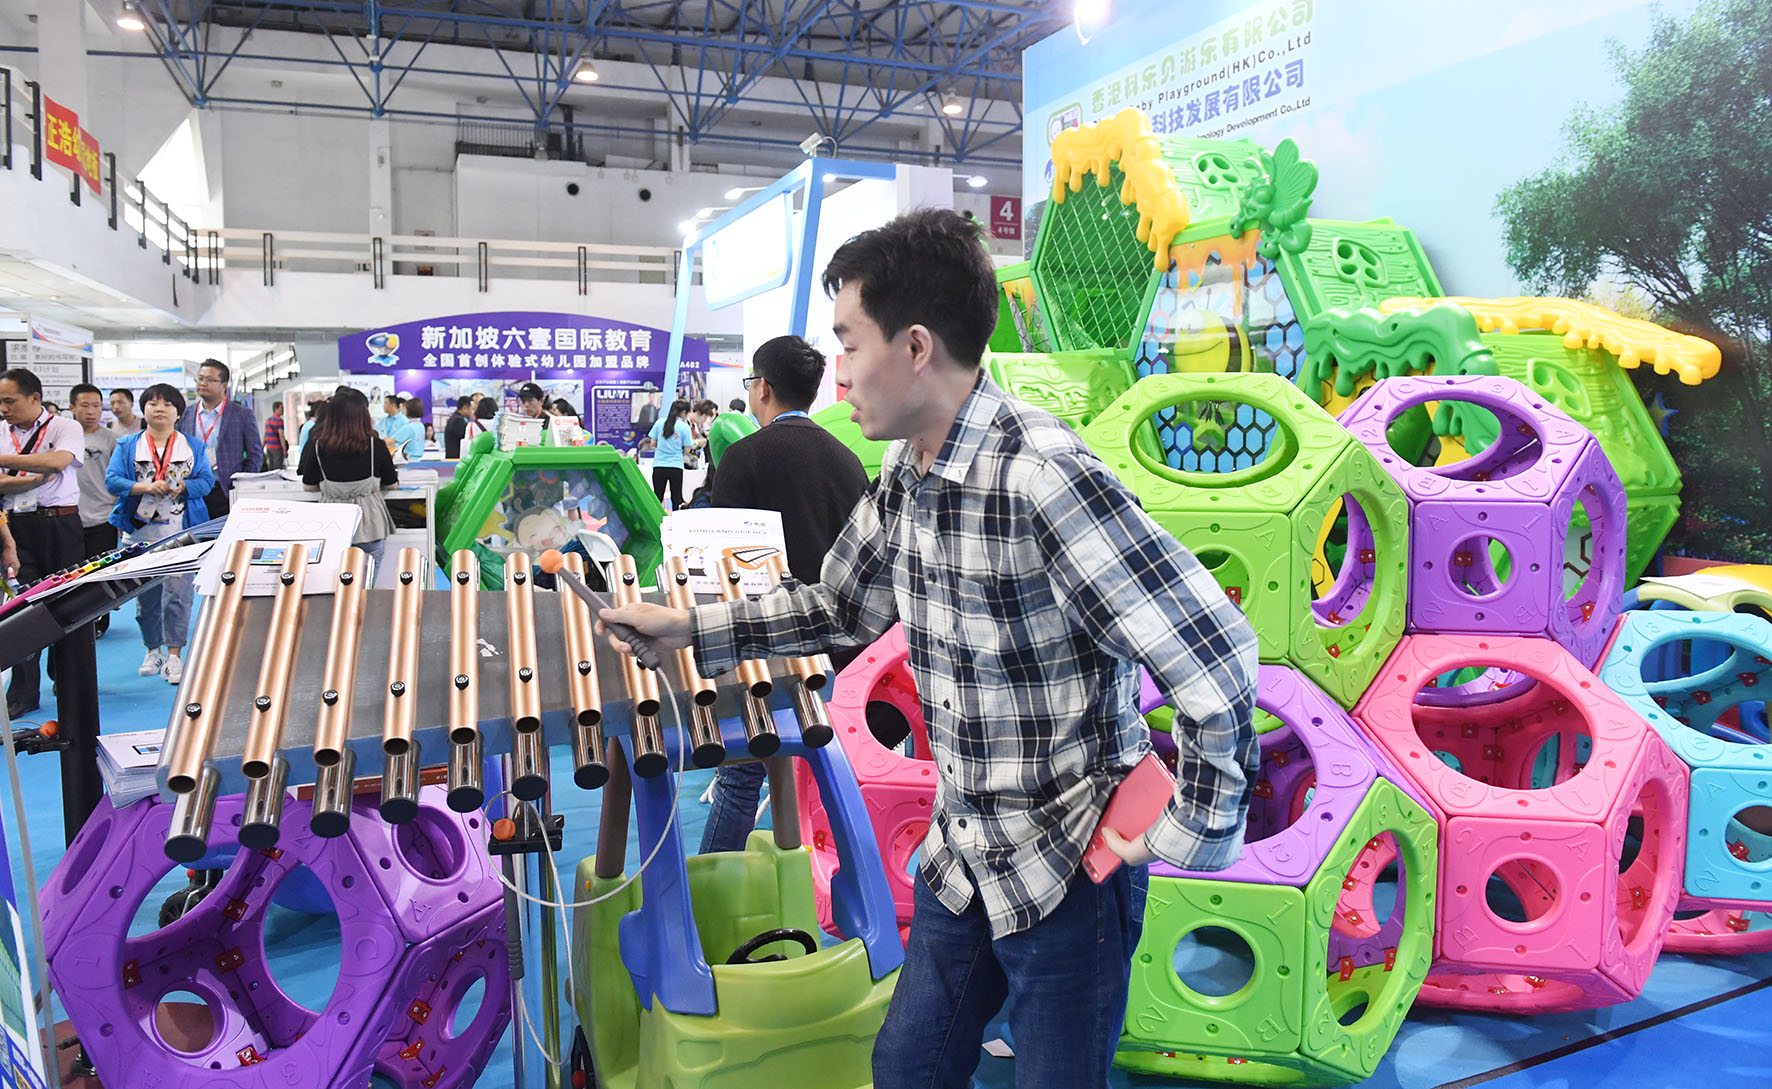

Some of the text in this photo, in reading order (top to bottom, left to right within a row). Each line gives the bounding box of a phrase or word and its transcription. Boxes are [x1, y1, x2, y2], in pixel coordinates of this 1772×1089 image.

[1091, 0, 1312, 114] 香港科乐贝游乐有限公司
[1152, 58, 1304, 134] 科技发展有限公司
[1226, 109, 1278, 132] Development
[1000, 201, 1014, 221] 4
[421, 326, 652, 351] 新加坡六壹国际教育
[423, 353, 650, 369] 全国首创体验式幼儿园加盟品牌
